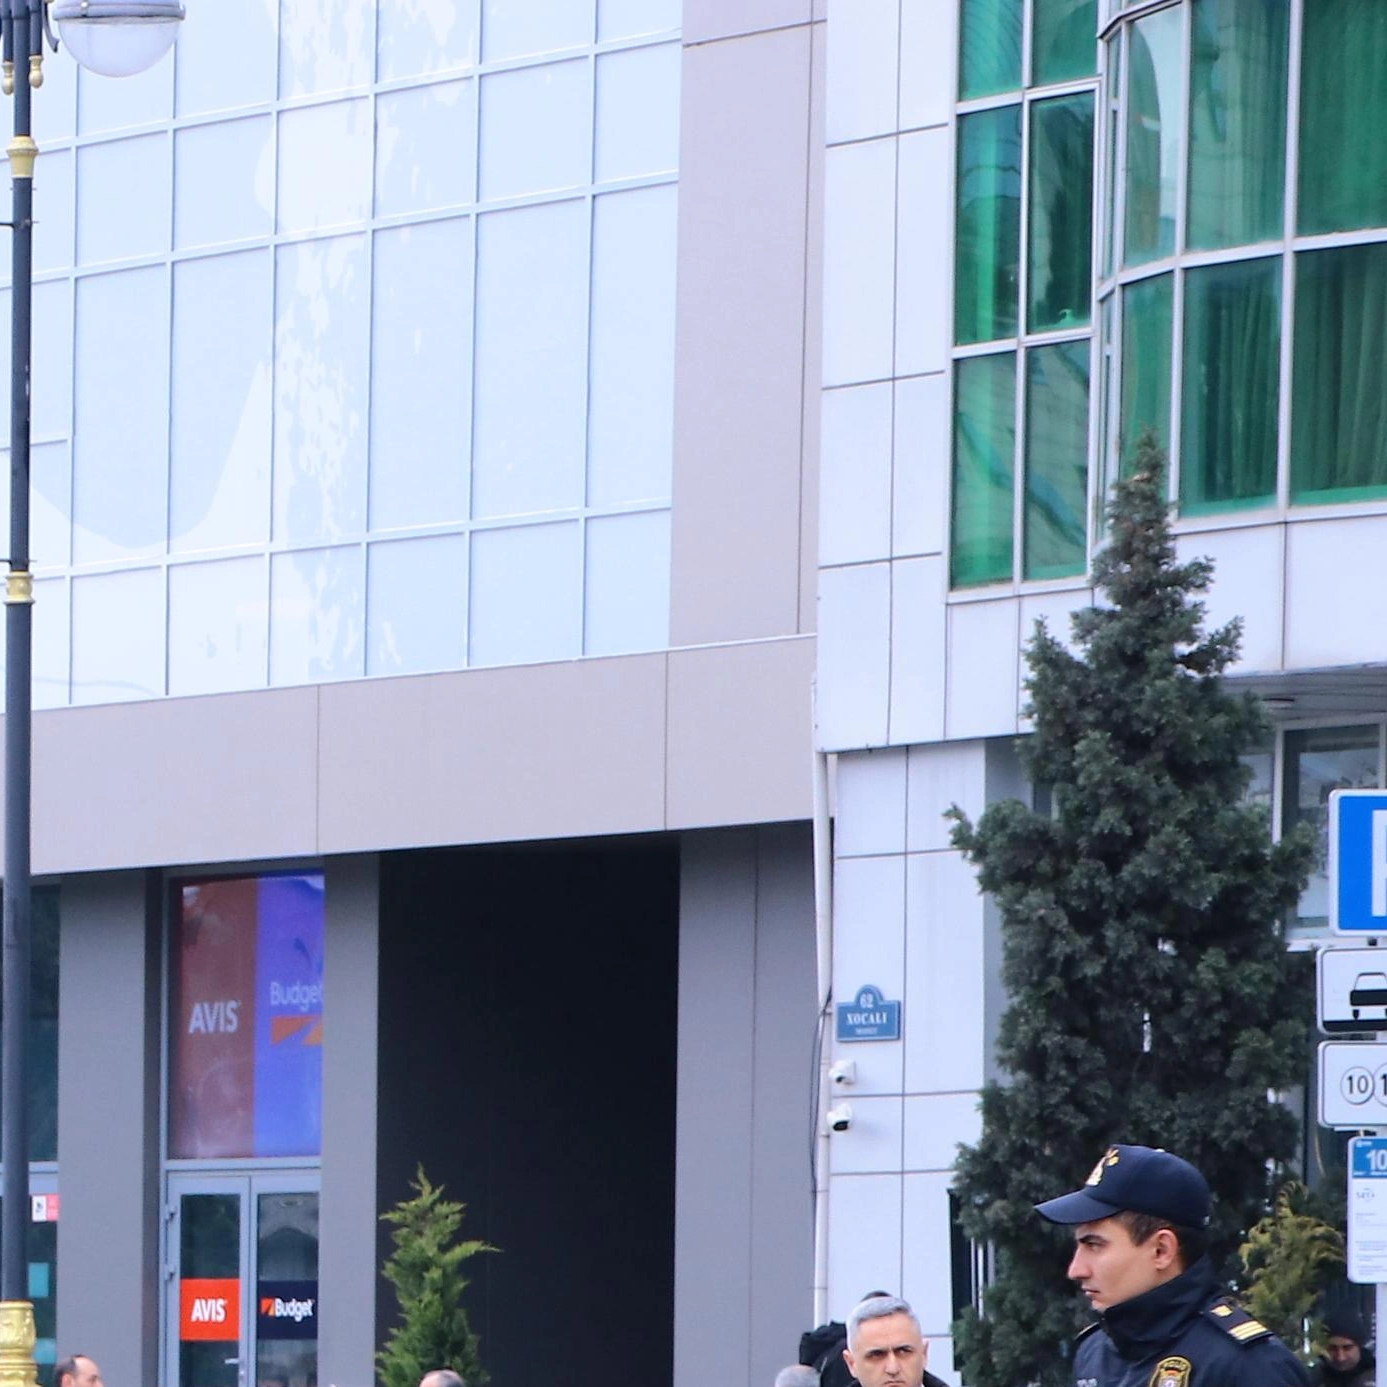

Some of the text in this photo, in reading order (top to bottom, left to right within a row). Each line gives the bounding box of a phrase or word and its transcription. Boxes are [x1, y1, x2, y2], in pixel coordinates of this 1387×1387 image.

[188, 1000, 238, 1034] AVIS
[1347, 1075, 1369, 1094] 10
[191, 1299, 226, 1322] AVIS
[274, 1298, 313, 1322] Budget
